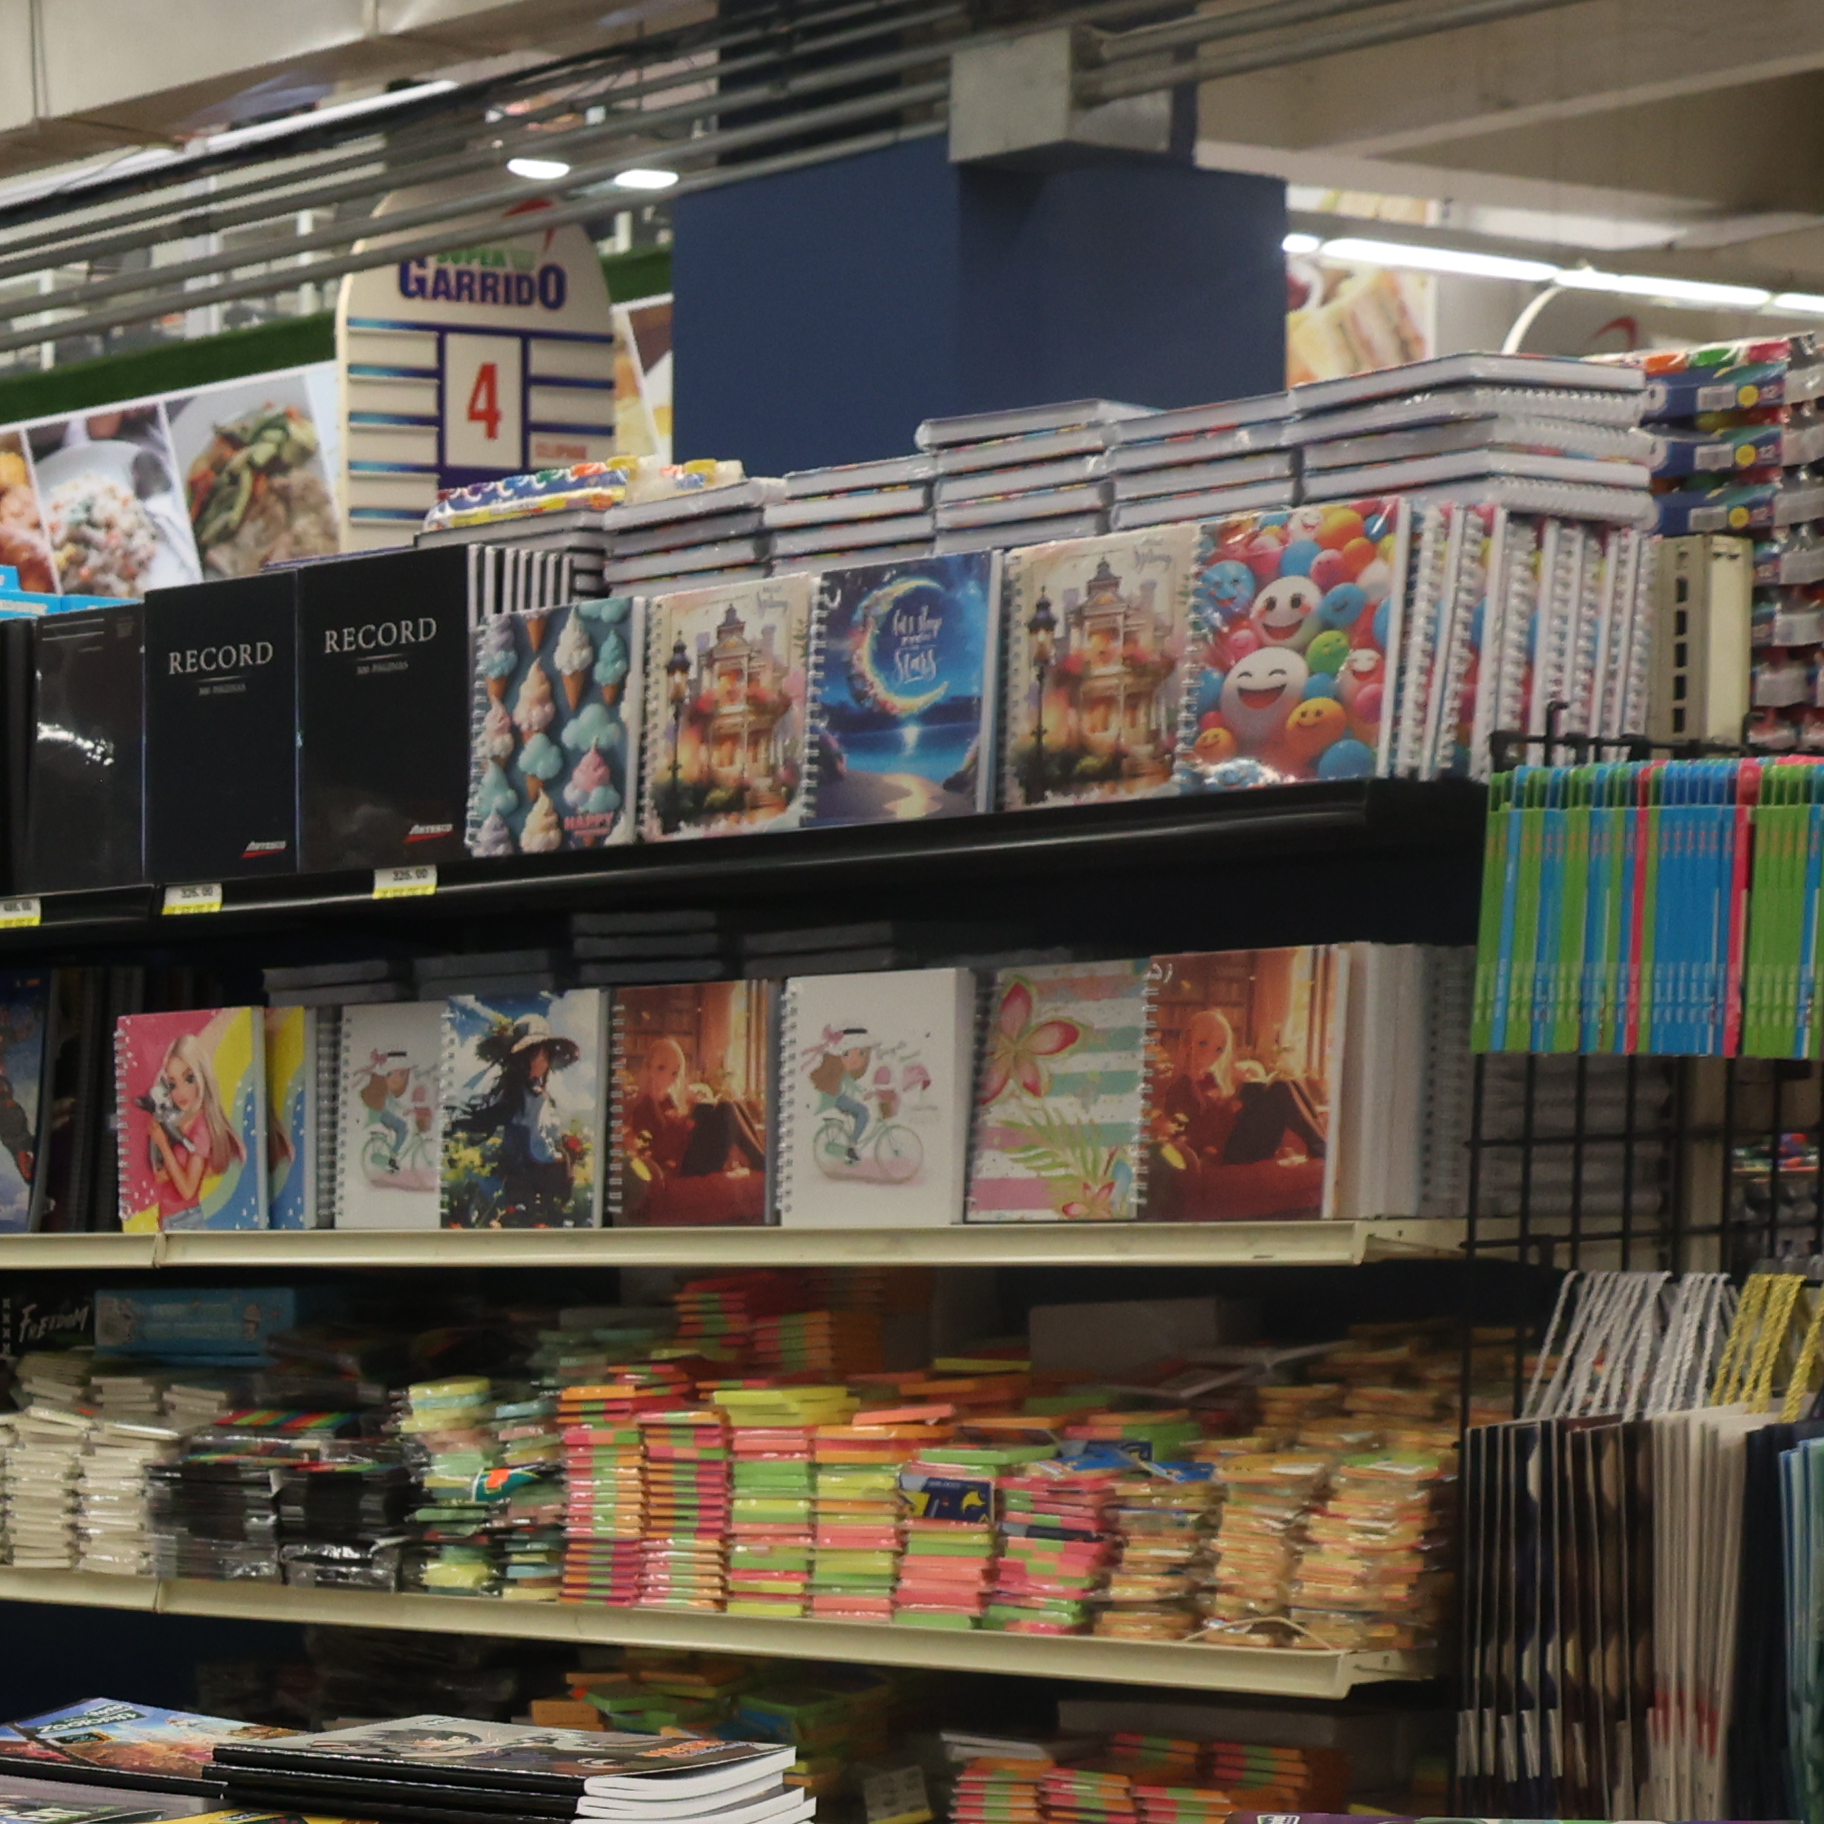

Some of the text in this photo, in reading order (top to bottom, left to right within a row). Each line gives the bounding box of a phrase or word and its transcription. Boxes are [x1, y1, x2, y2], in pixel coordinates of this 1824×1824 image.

[399, 257, 566, 310] GARRIDO
[467, 363, 501, 439] 4
[324, 617, 437, 654] RECORD
[168, 642, 273, 675] RECORD
[17, 1303, 89, 1343] FREEDOM
